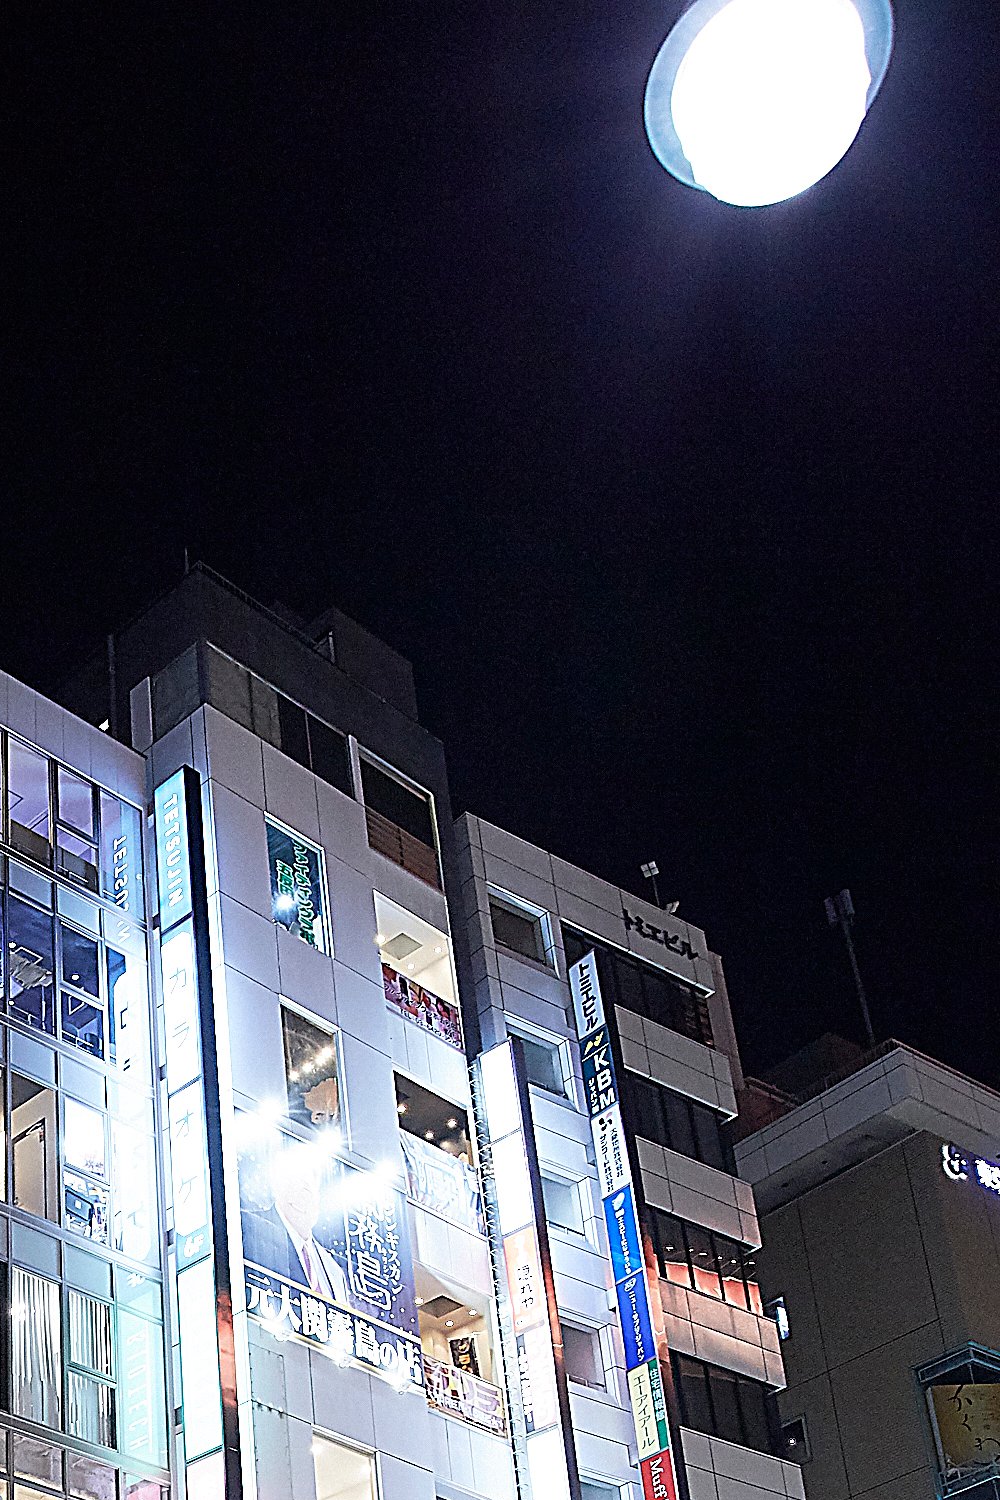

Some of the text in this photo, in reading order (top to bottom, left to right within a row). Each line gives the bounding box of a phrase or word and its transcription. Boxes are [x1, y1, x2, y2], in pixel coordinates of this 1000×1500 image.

[162, 793, 185, 909] TETSUJIN
[578, 961, 599, 1033] トミエビル
[594, 1053, 617, 1109] KBM
[633, 1373, 656, 1450] エーアイアール
[649, 1456, 669, 1500] Muff
